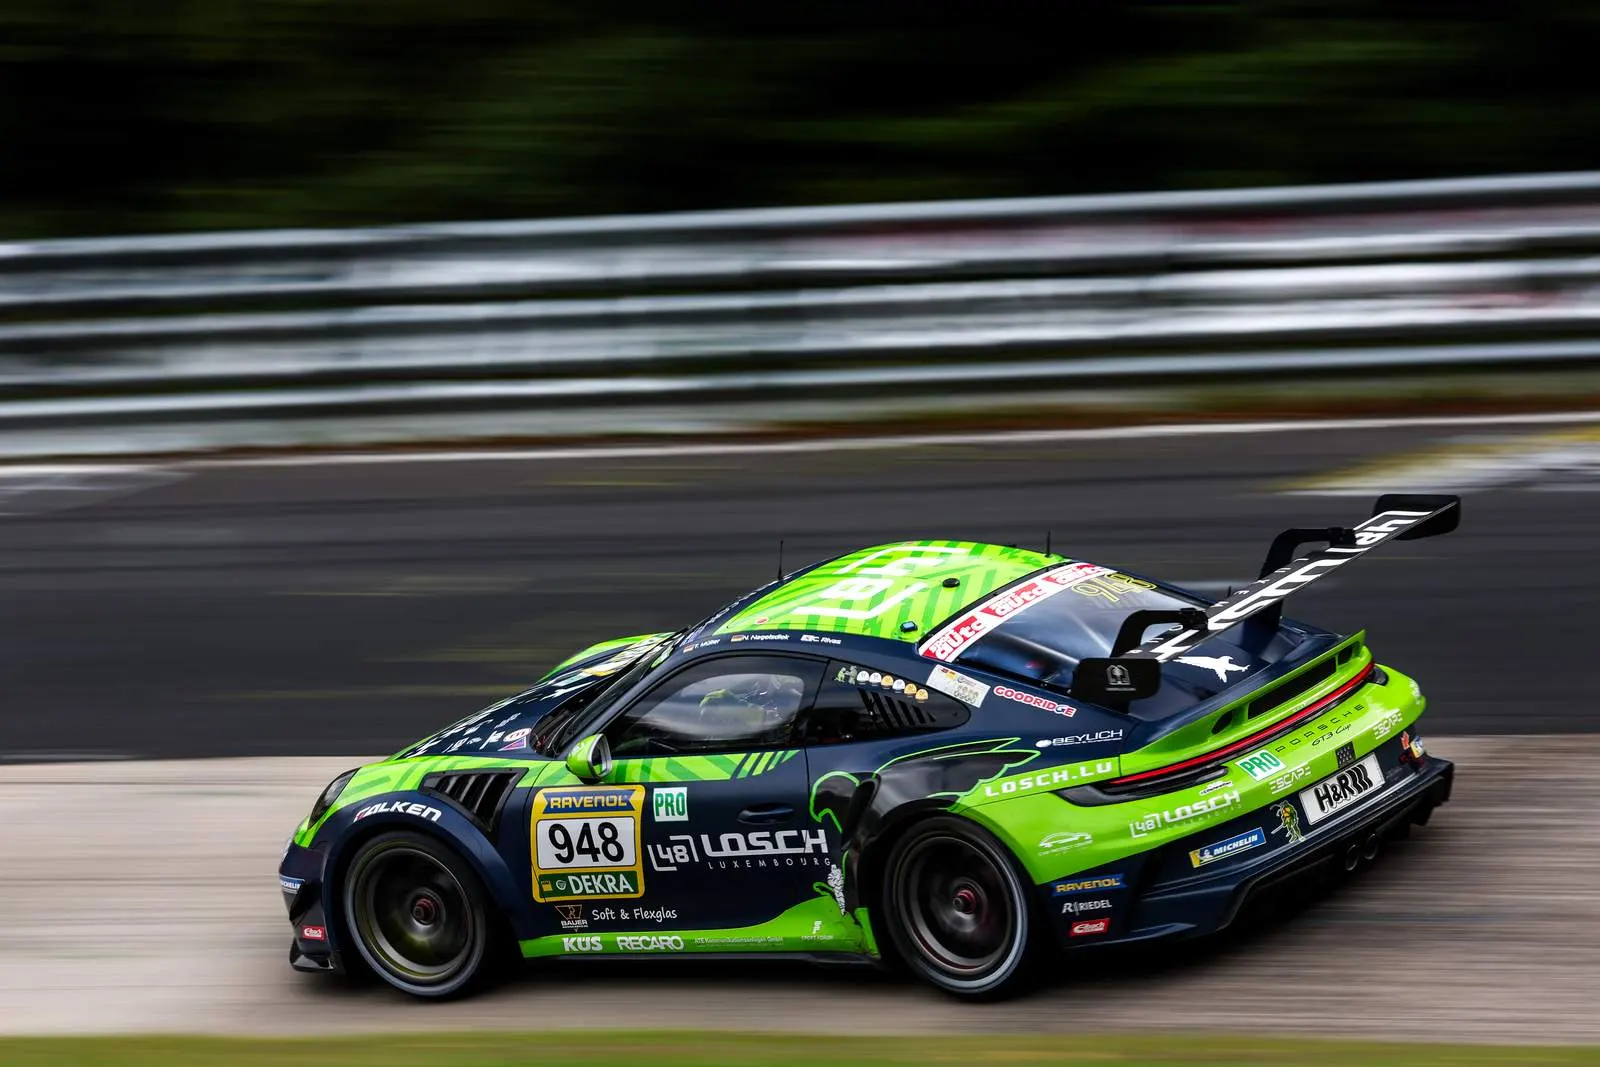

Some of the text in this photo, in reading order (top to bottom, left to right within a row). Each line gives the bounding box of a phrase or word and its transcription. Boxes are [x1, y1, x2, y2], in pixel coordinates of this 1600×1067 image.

[993, 686, 1077, 718] GOODRIDGE
[1052, 729, 1123, 744] BEYLICH
[1275, 704, 1364, 753] PORSCHE
[1239, 752, 1281, 777] PRO
[984, 761, 1113, 797] LOSCH.LU
[354, 801, 442, 823] FALKEN
[550, 795, 627, 809] RAVENOL
[655, 792, 686, 817] PRO
[1163, 790, 1241, 823] LOSCH
[548, 822, 625, 864] 948
[700, 829, 829, 857] LOSCH
[1213, 834, 1258, 855] MICHELIN
[708, 857, 831, 870] LUXEMBOURG
[568, 874, 634, 895] DEKRA
[1056, 878, 1121, 893] RAVENOL
[591, 906, 678, 922] Soft & Flexglas
[1079, 900, 1113, 911] RIEDEL
[616, 936, 684, 950] RECARO
